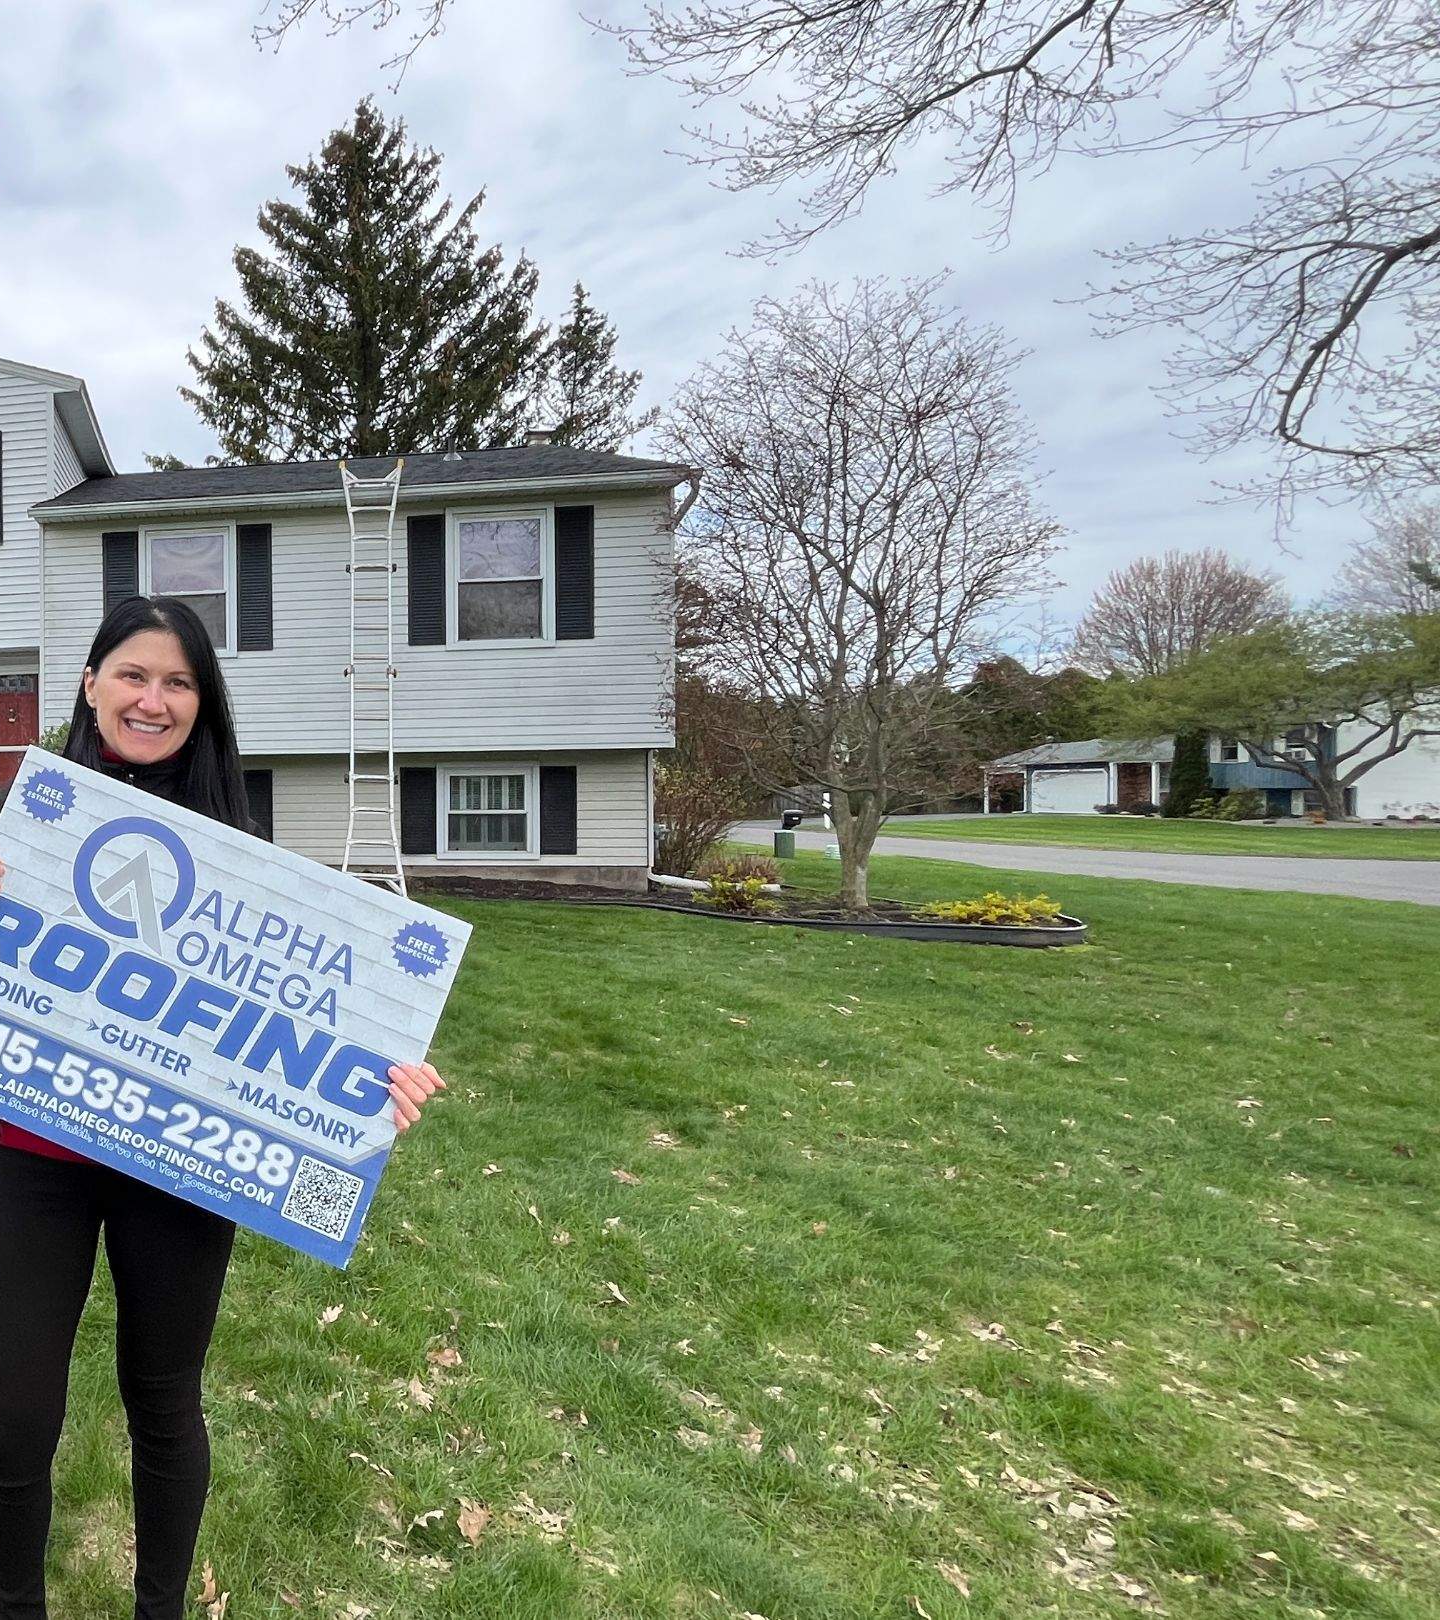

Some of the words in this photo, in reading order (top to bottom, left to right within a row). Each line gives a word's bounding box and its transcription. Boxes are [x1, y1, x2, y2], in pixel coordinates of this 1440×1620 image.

[26, 790, 66, 811] ESTIMATES
[36, 783, 64, 802] FREE
[189, 889, 352, 986] ALPHA
[395, 943, 442, 967] INSPECTION
[407, 935, 437, 955] FREE
[176, 931, 336, 1027] OMEGA
[100, 1023, 192, 1077] GUTTER
[237, 1081, 366, 1150] MASONRY
[7, 1097, 39, 1118] Start
[40, 1111, 54, 1124] to
[133, 1152, 156, 1170] Got
[159, 1161, 180, 1180] You
[182, 1173, 232, 1203] Covered
